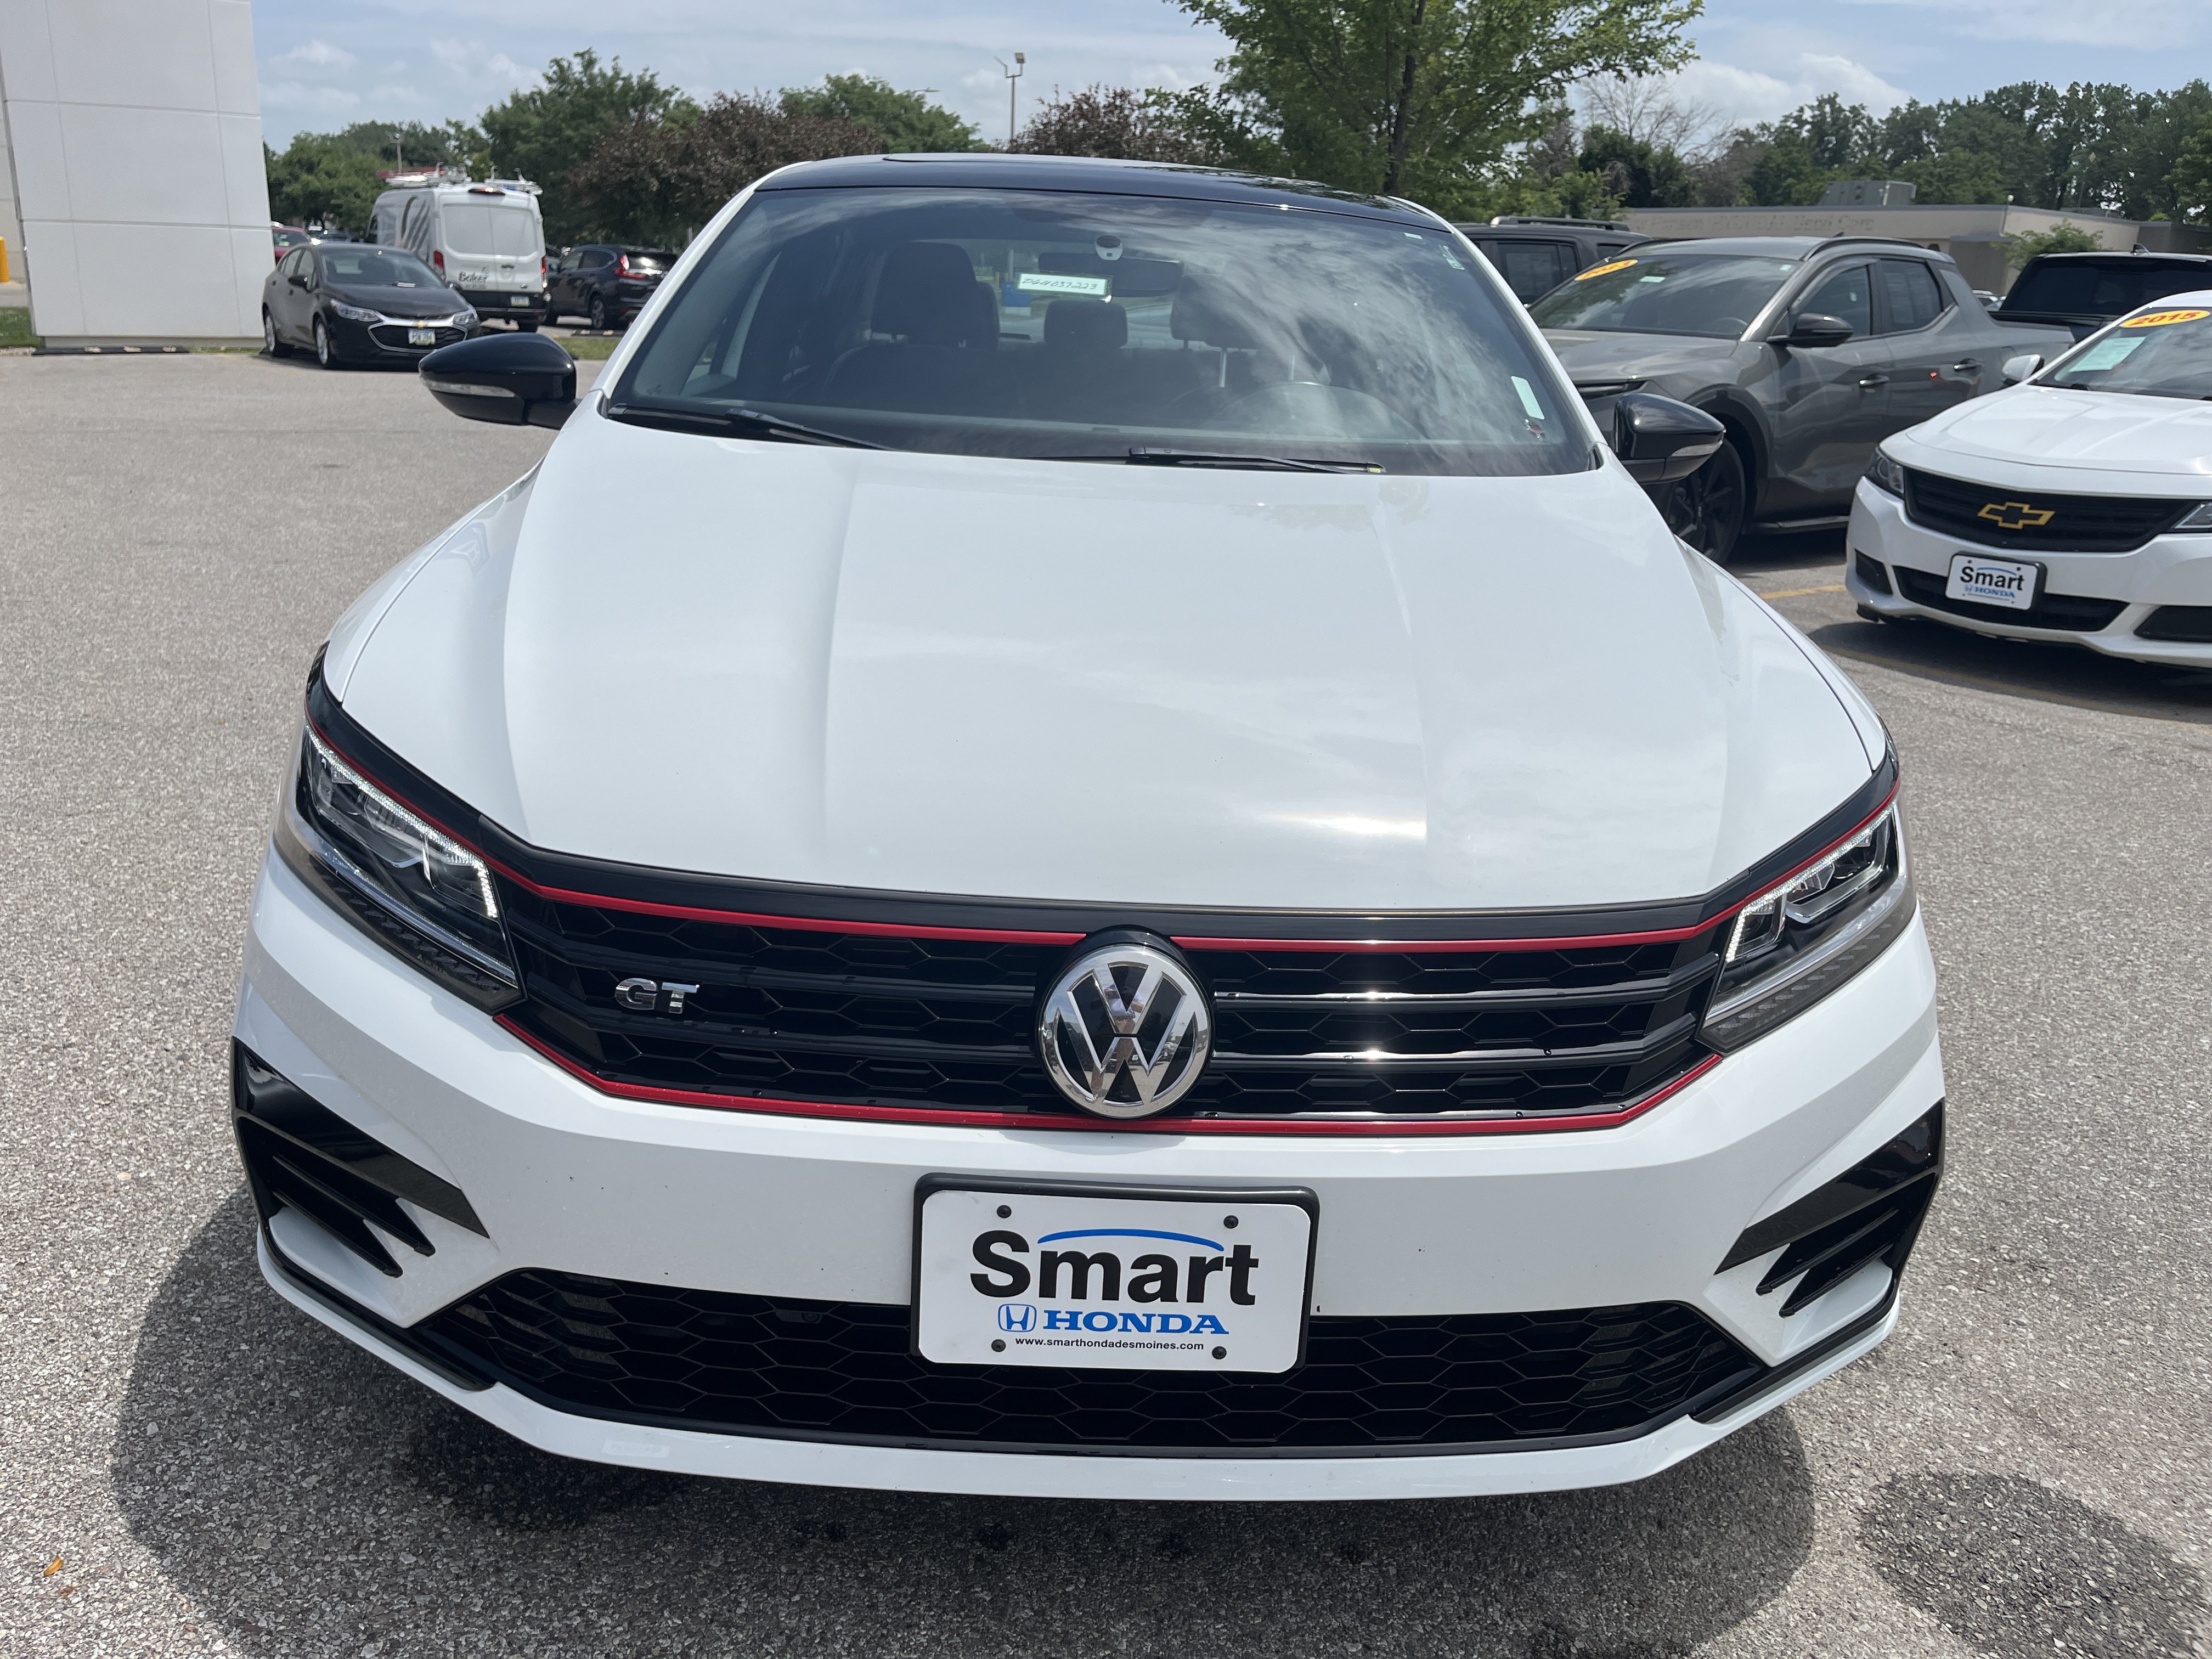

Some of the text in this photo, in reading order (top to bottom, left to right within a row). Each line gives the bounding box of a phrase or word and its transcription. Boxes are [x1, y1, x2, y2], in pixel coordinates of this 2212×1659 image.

[1960, 566, 2024, 591] Smart
[1974, 587, 2016, 598] HONDA
[614, 978, 700, 1014] GT
[970, 1229, 1259, 1305] Smart
[1043, 1309, 1229, 1334] HONDA
[1015, 1336, 1204, 1350] www.smarthondadesmoines.com
